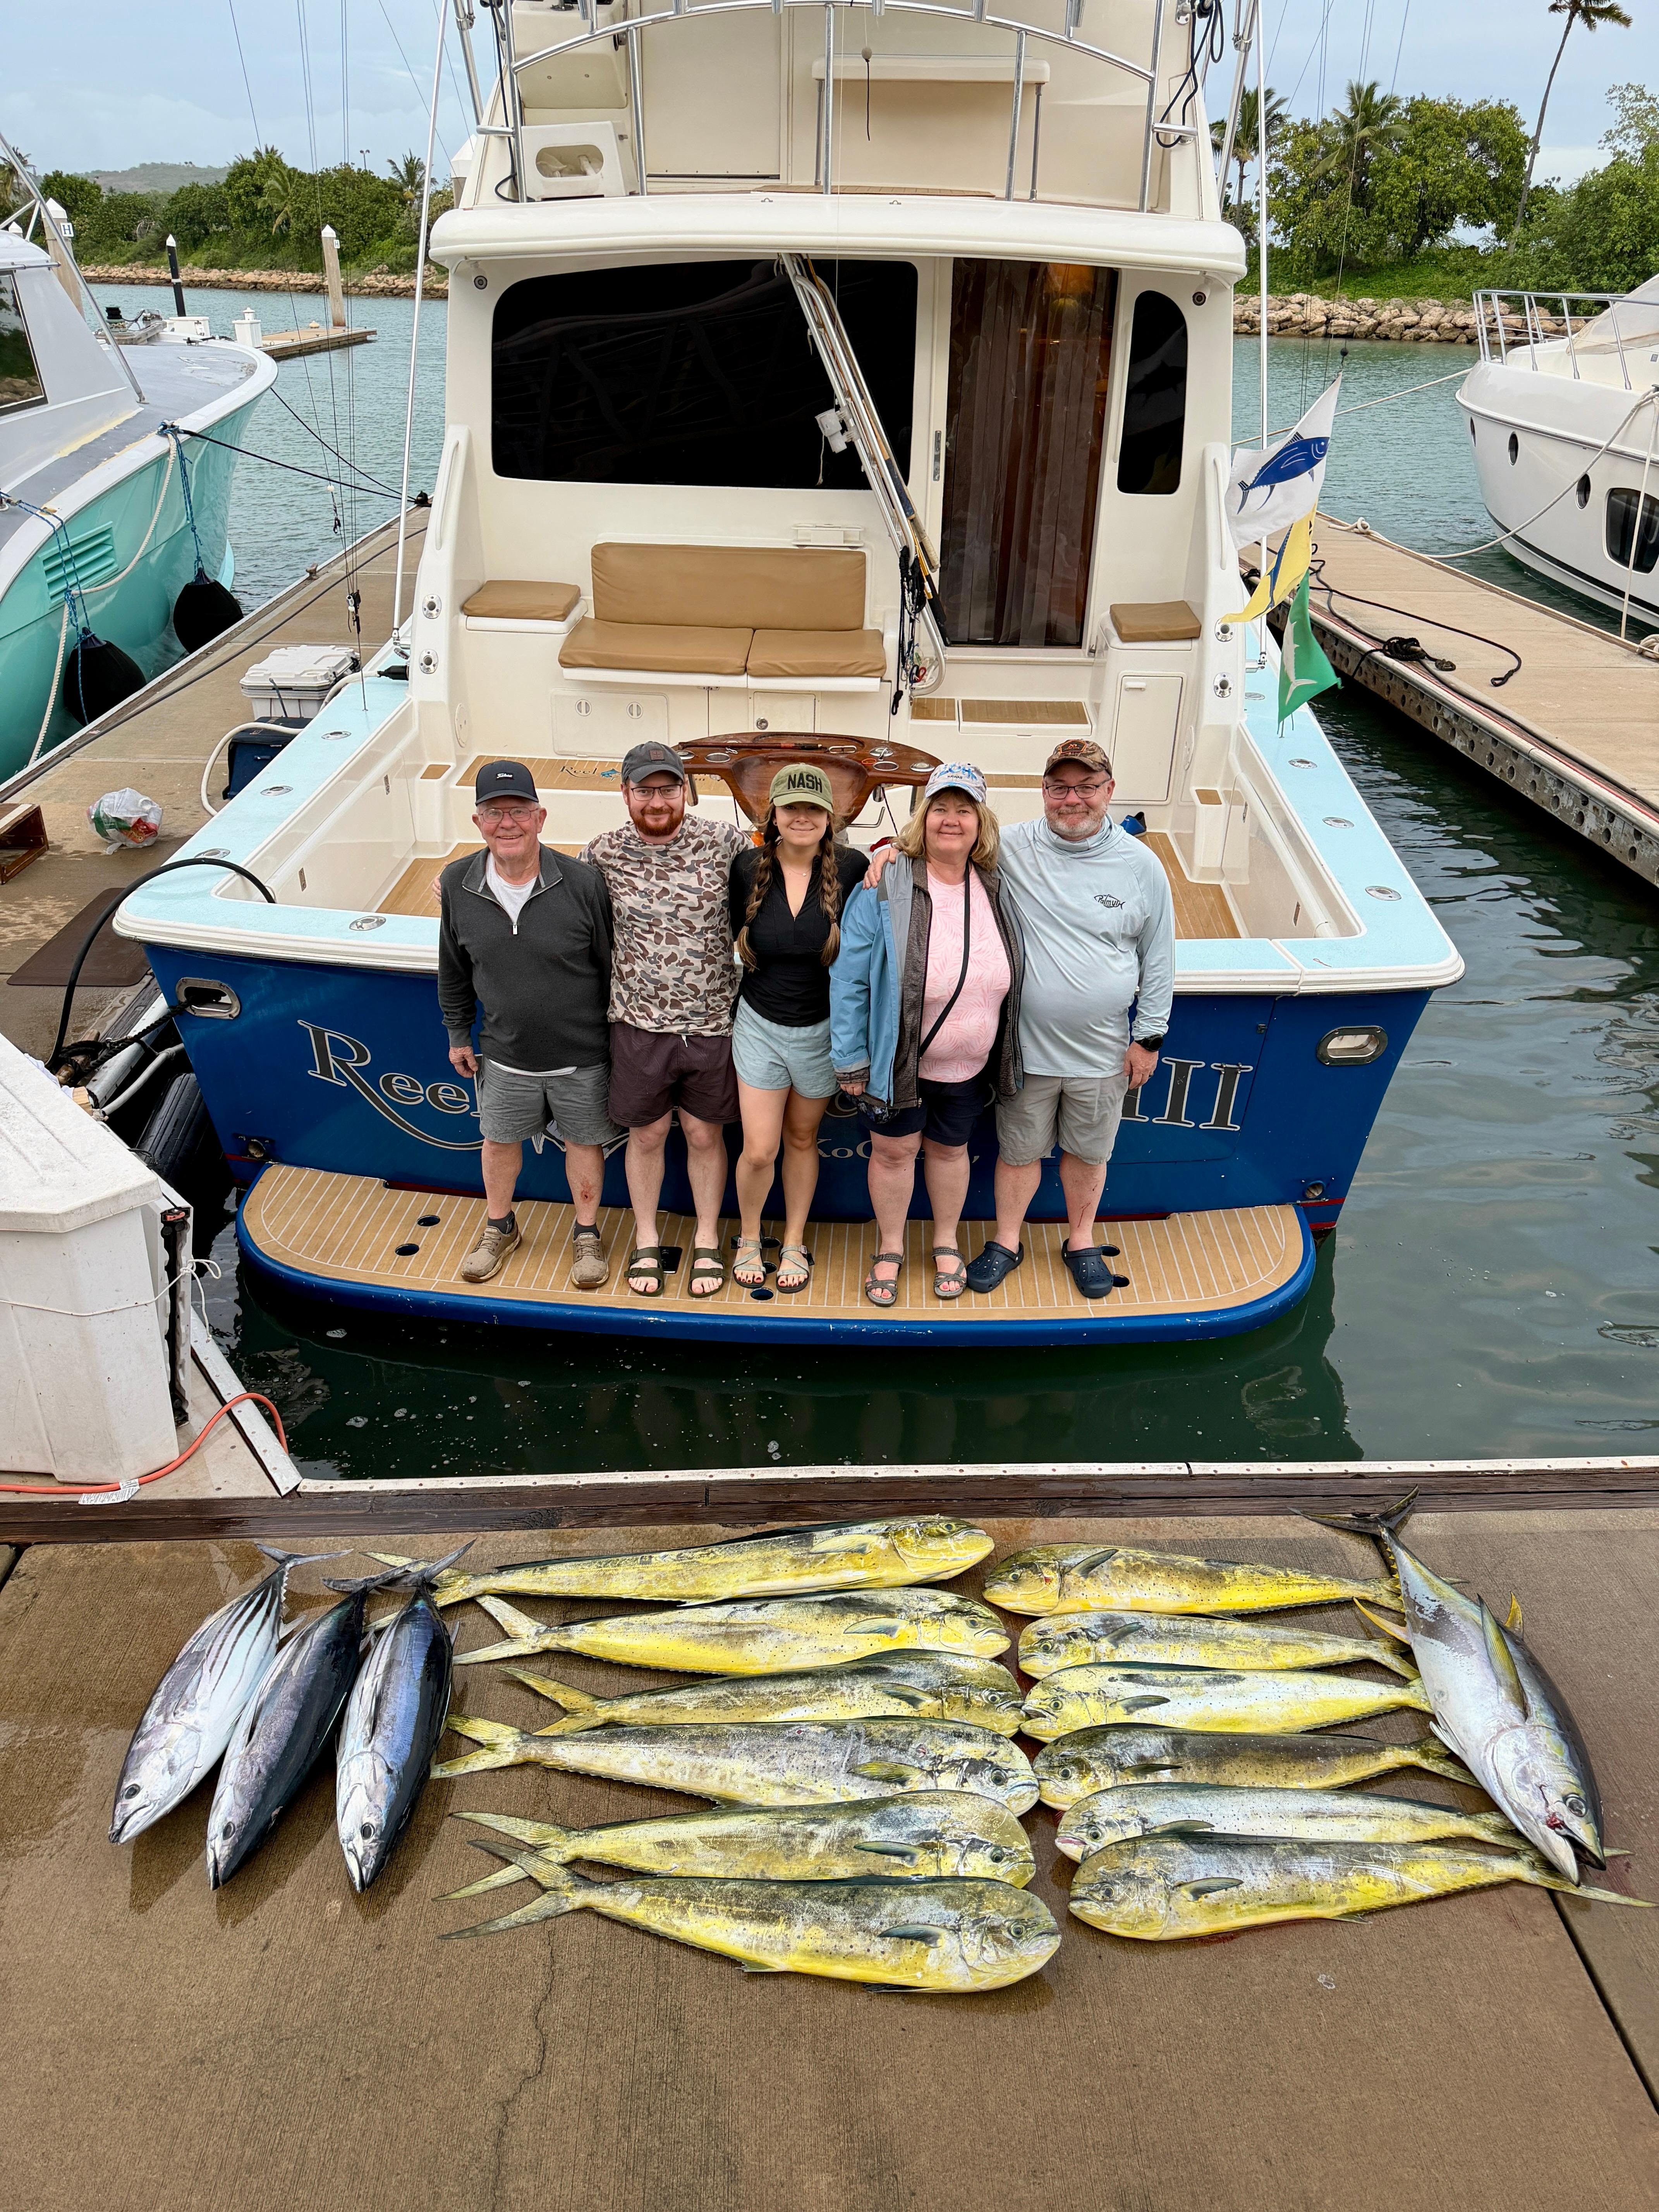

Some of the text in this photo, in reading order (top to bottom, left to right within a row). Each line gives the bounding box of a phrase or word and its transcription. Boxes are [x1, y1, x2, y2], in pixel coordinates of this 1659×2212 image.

[62, 225, 72, 234] H
[788, 773, 822, 793] NASH
[297, 1019, 485, 1151] Ree
